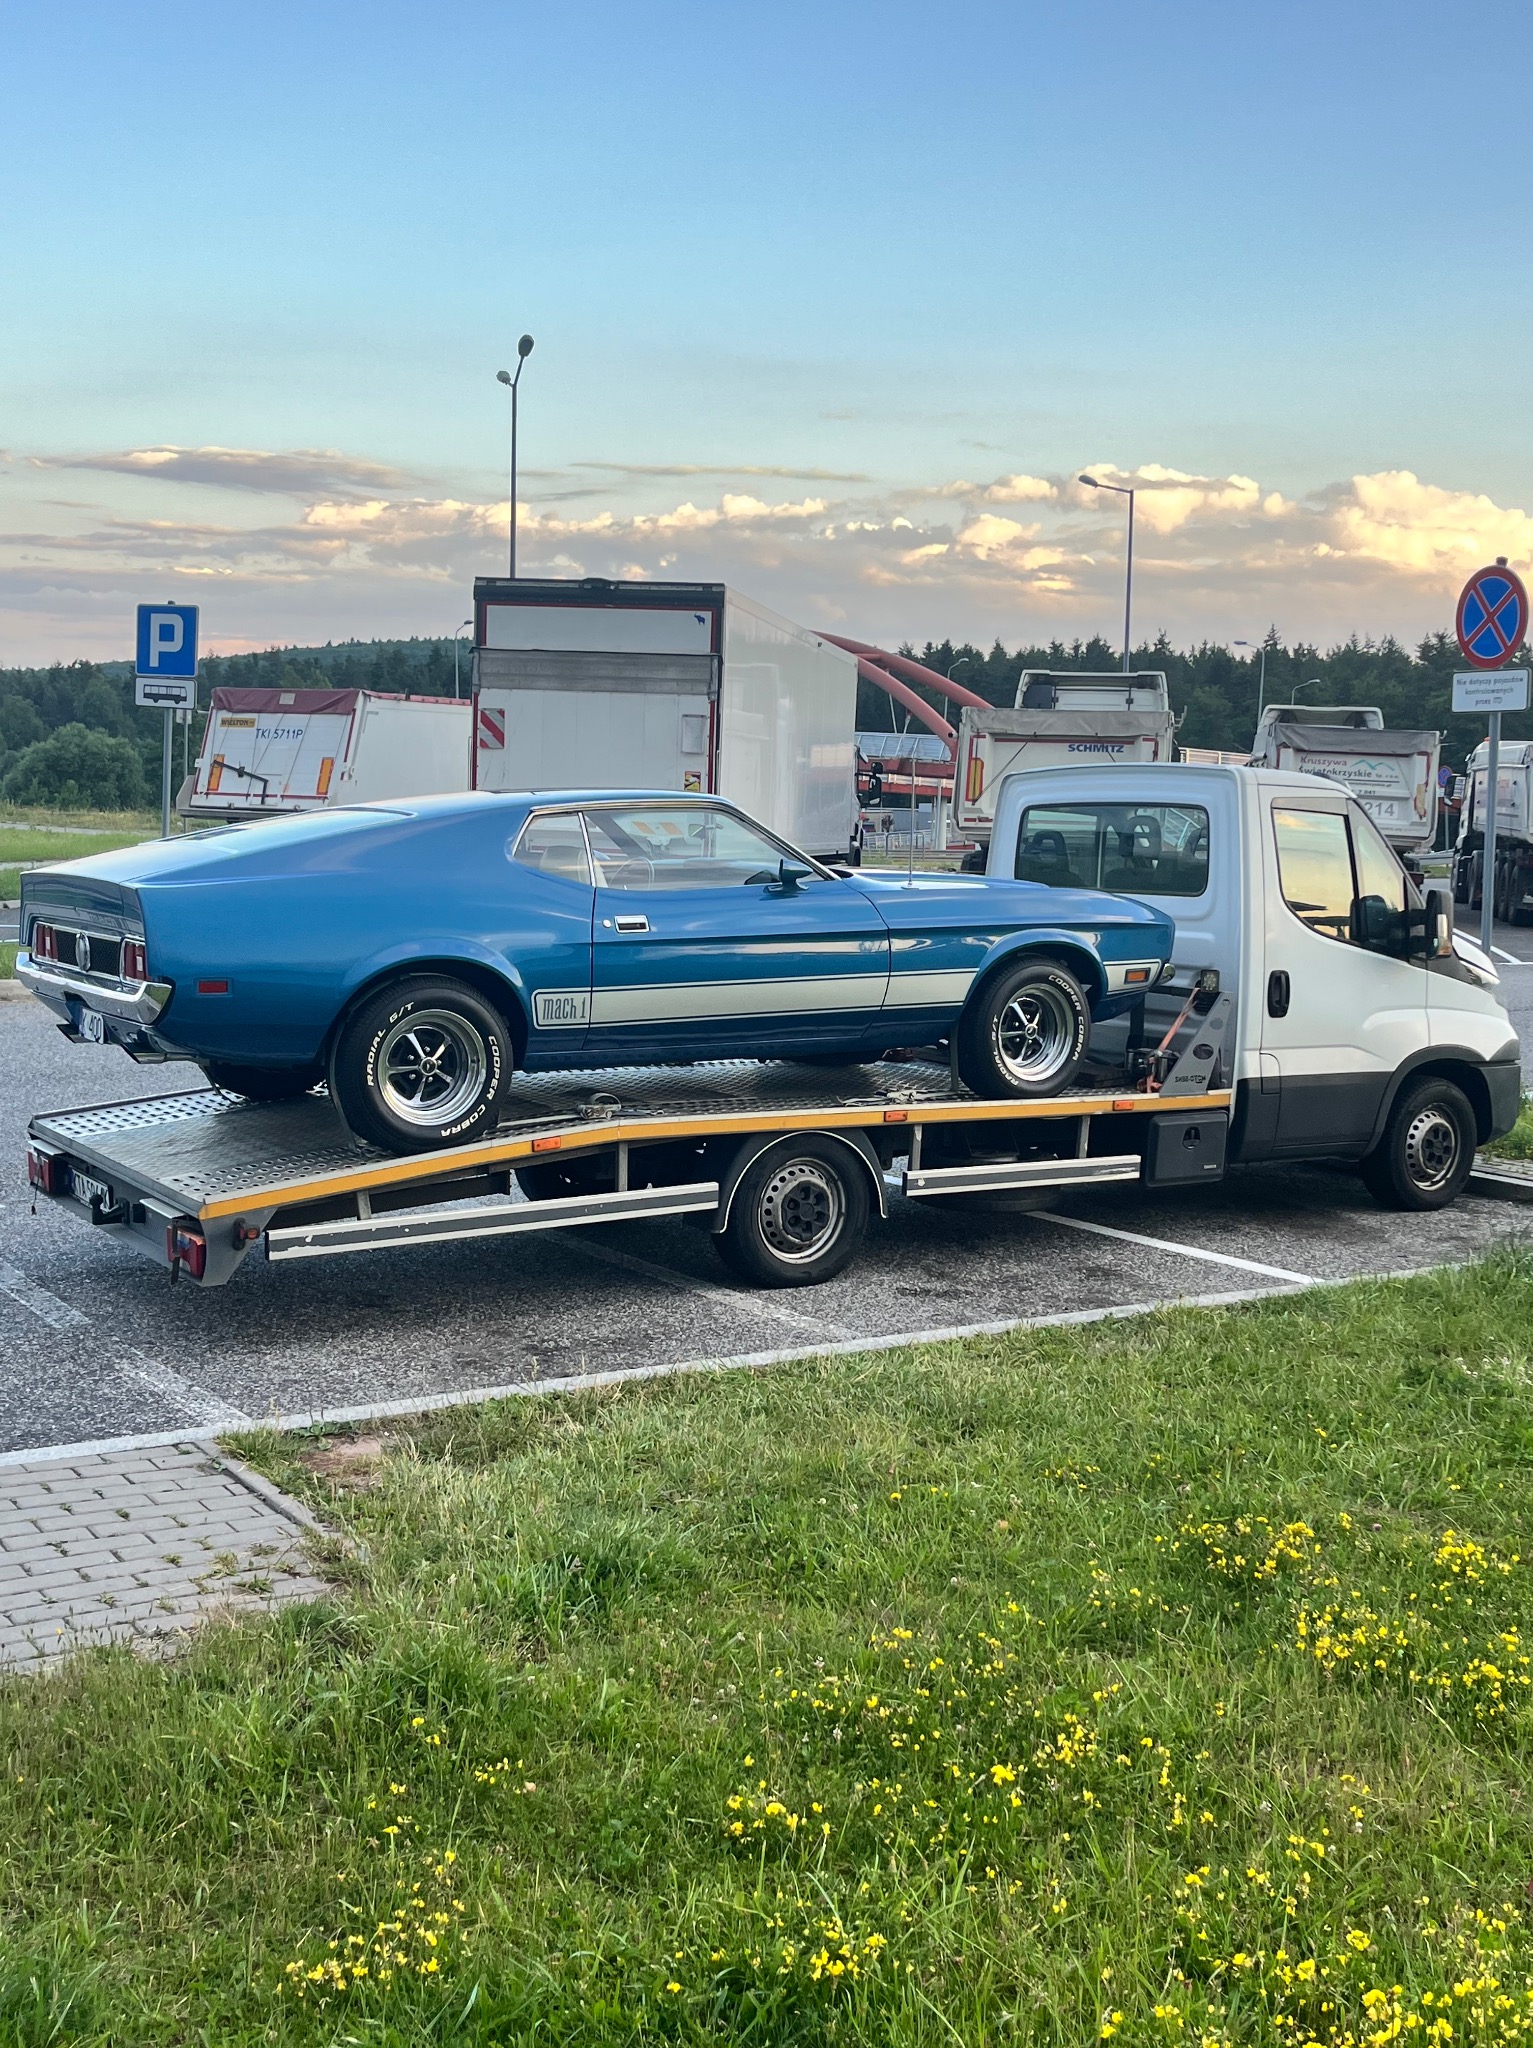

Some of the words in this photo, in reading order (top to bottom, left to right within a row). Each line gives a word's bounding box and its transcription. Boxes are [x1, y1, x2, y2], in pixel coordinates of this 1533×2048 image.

[149, 613, 184, 668] P
[273, 729, 303, 739] 5711P
[1067, 744, 1124, 753] SCHMITZ
[1300, 755, 1347, 767] Kruszywa
[580, 997, 586, 1019] 1
[1048, 974, 1081, 1011] COOPER
[1072, 1016, 1084, 1061] COBRA
[366, 1028, 386, 1087] RADIAL
[389, 1002, 414, 1023] G/T
[486, 1035, 500, 1100] COOPER
[993, 1047, 1019, 1086] RADIAL
[440, 1103, 486, 1137] COBRA
